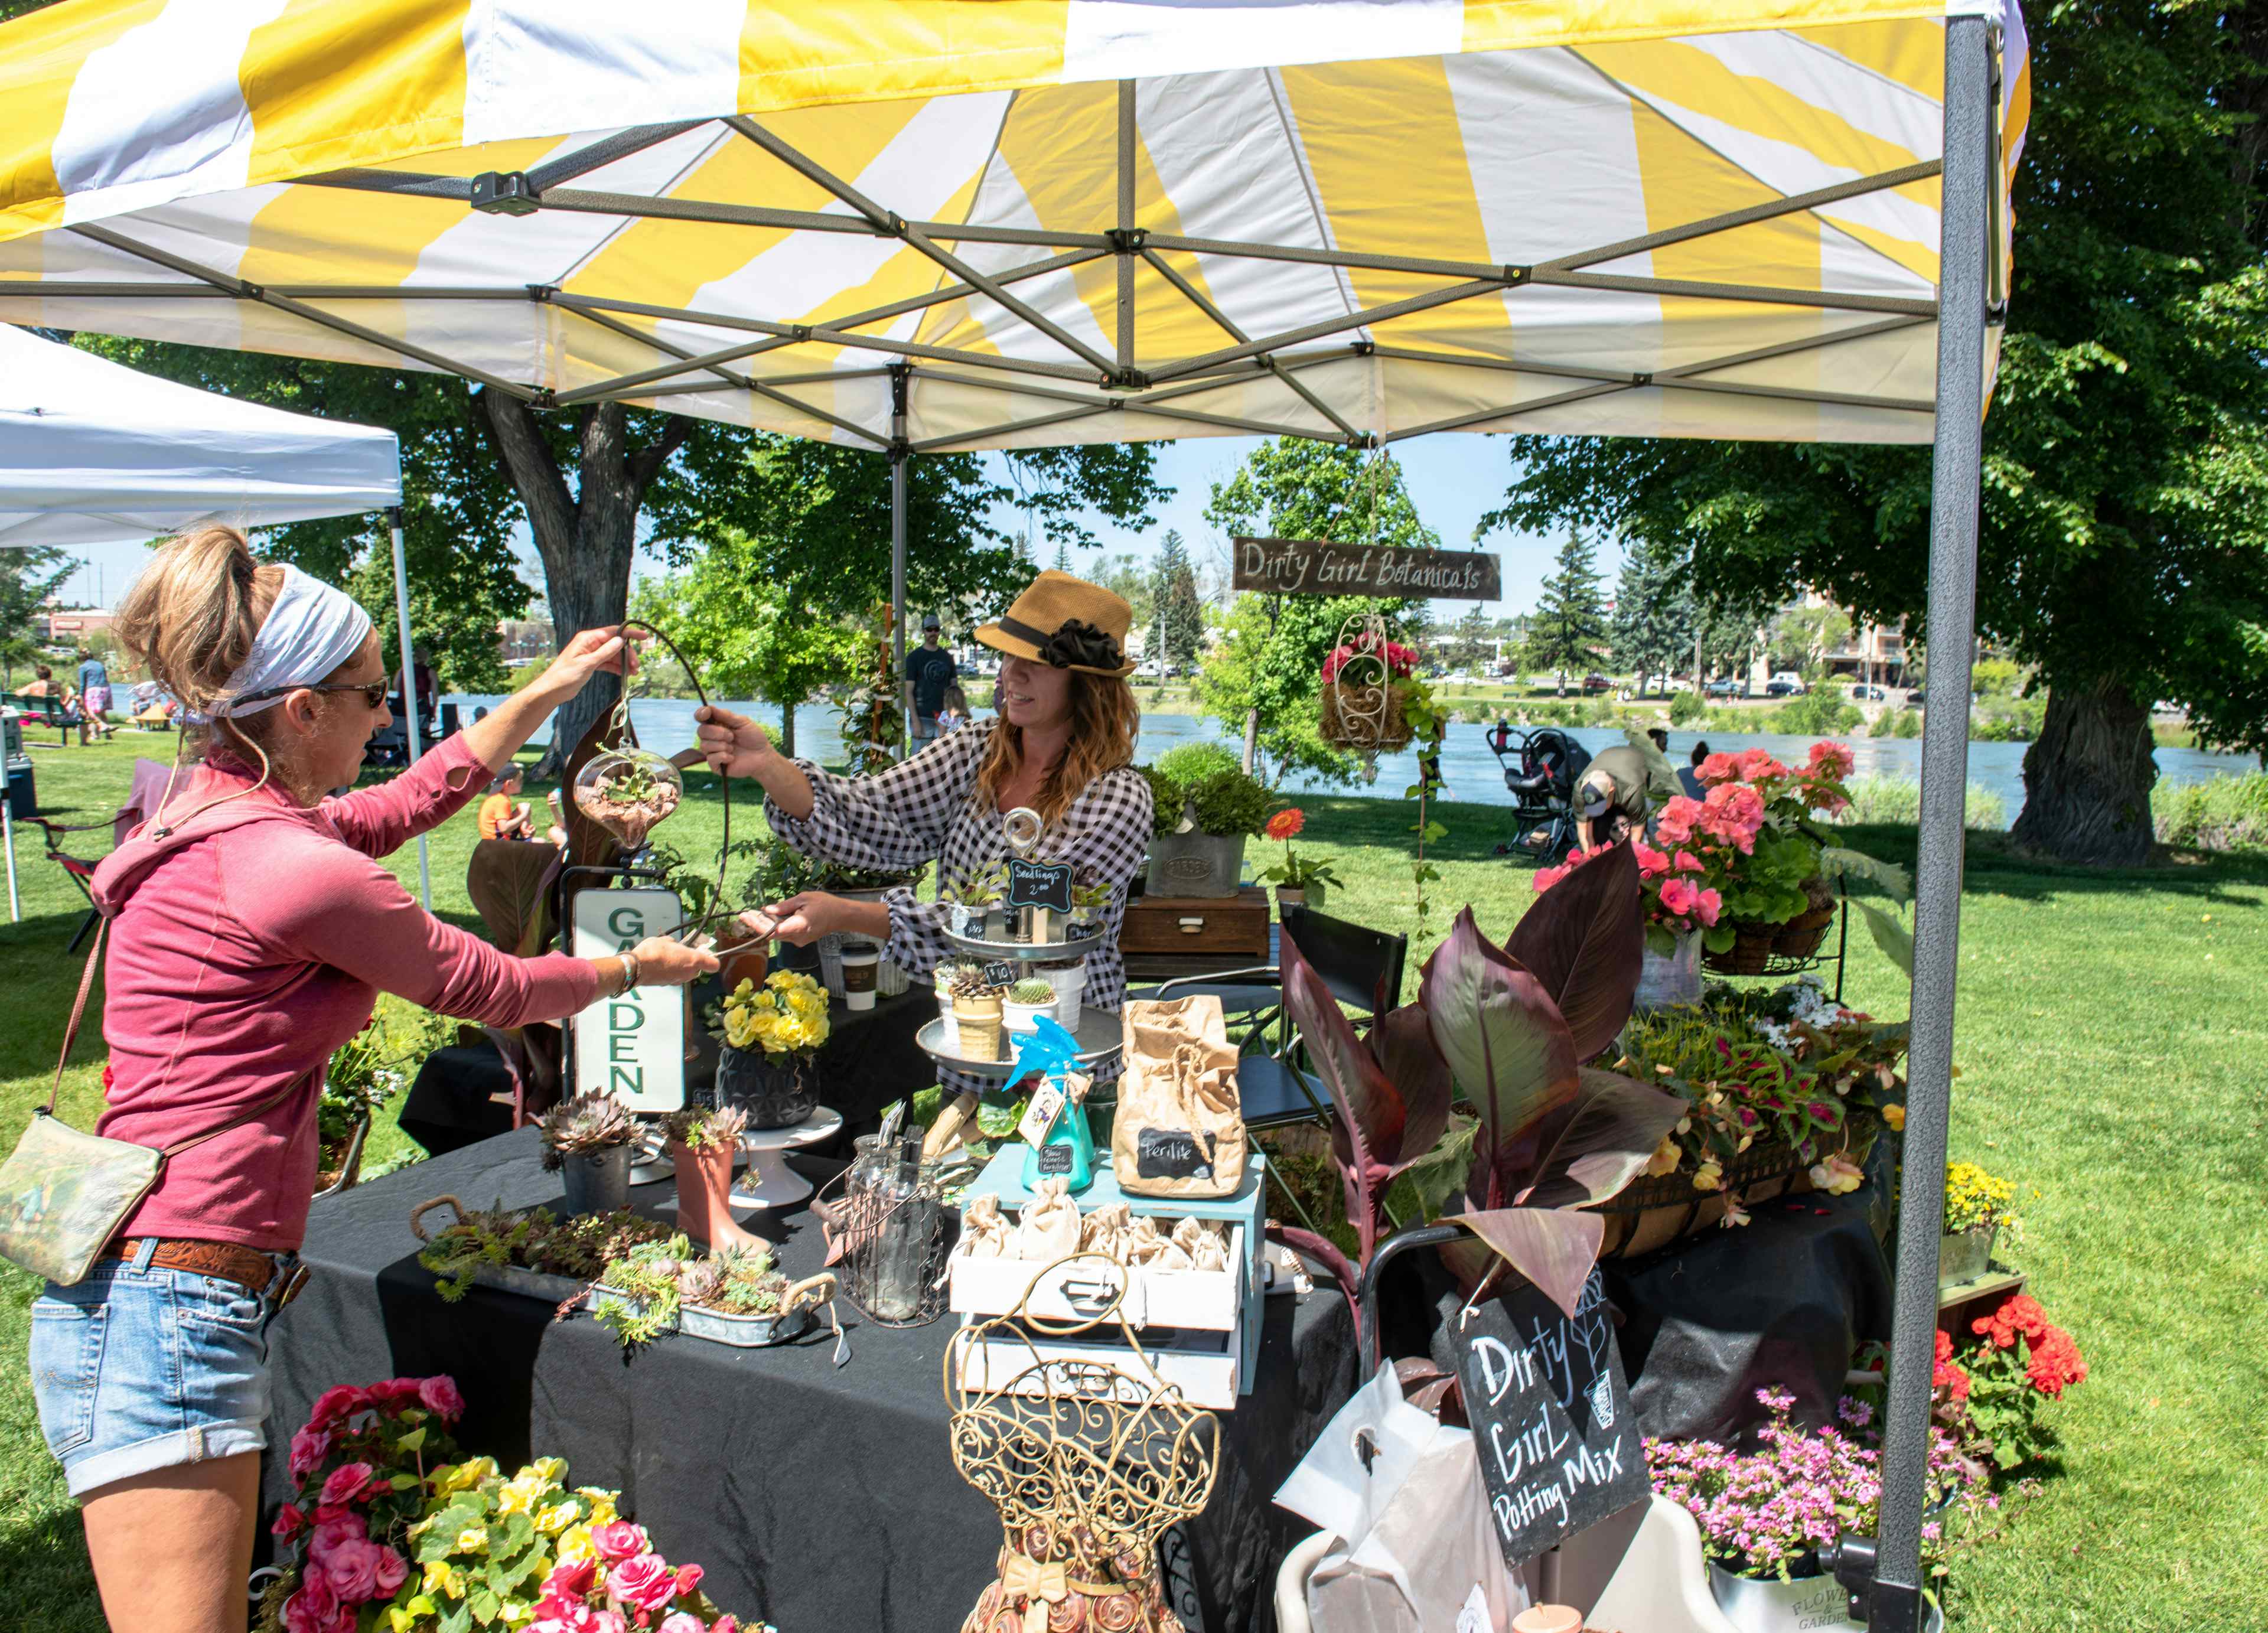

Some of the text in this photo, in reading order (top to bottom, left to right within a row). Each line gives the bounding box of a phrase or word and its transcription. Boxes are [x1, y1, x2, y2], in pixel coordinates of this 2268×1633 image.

[1243, 542, 1310, 591] Dirty
[1376, 551, 1480, 589] Botanicals
[1015, 865, 1060, 885] Seedlings
[608, 907, 645, 1094] GDEN
[1471, 1316, 1573, 1408] Dirty
[1493, 1435, 1623, 1540] Potting Mix
[1792, 1588, 1847, 1616] FLOWE
[1823, 1603, 1833, 1615] &
